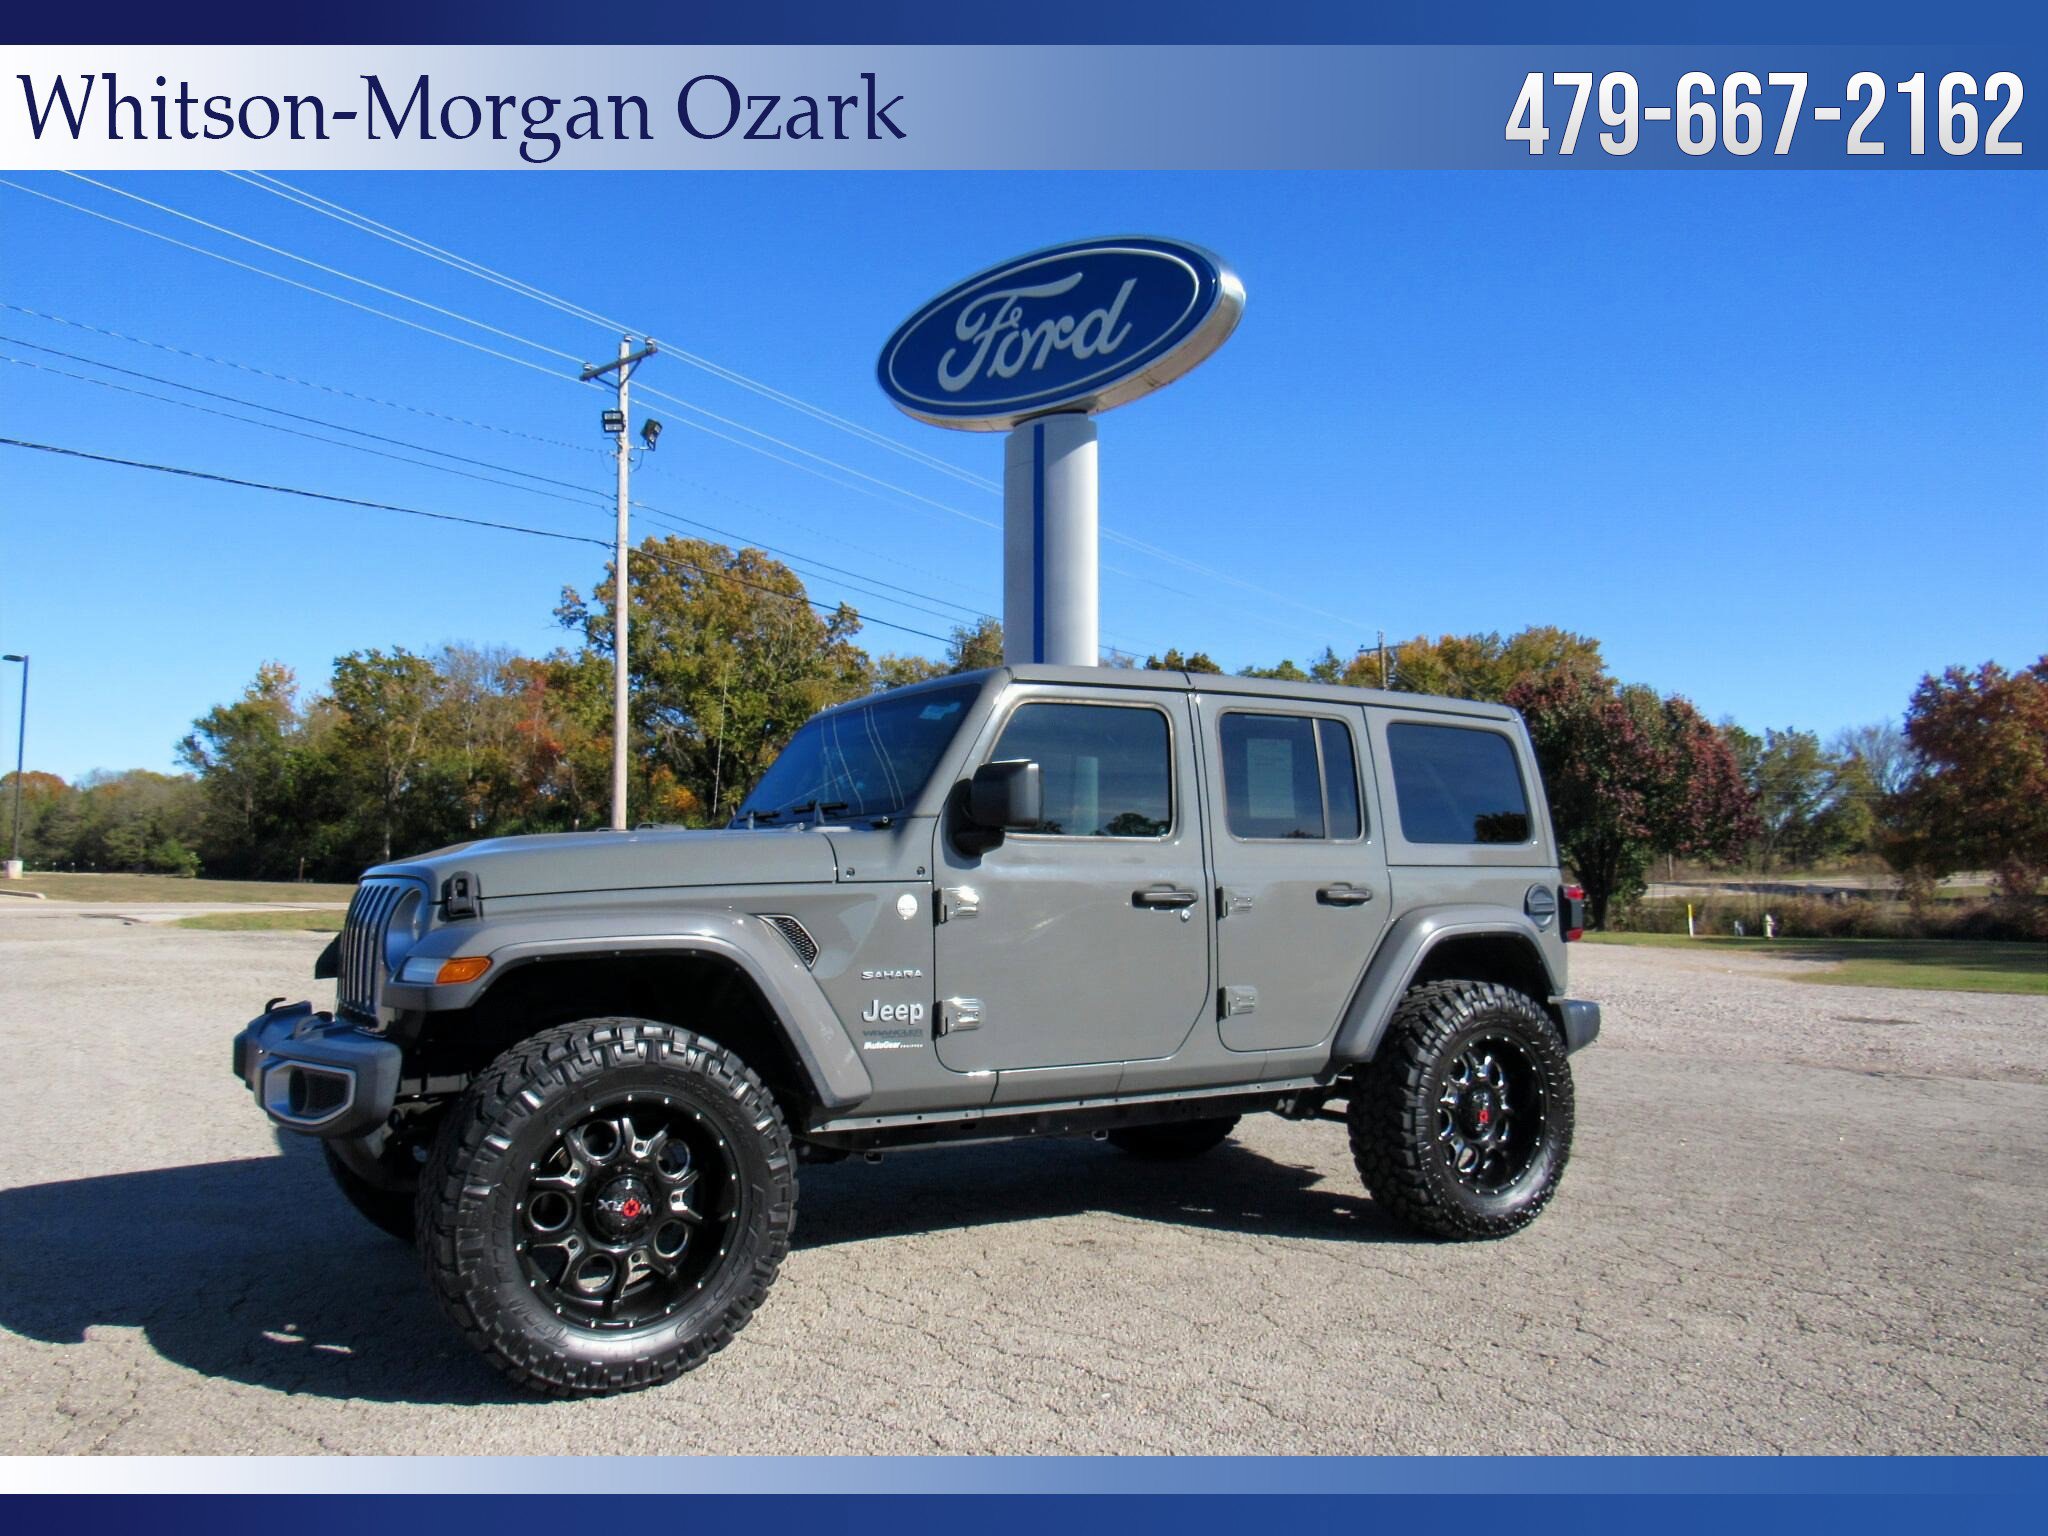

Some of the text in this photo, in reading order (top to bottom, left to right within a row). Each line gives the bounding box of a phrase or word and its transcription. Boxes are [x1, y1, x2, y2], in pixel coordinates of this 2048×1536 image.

[937, 271, 1137, 392] Ford
[861, 969, 923, 980] SAHARA
[862, 999, 925, 1025] Jeep
